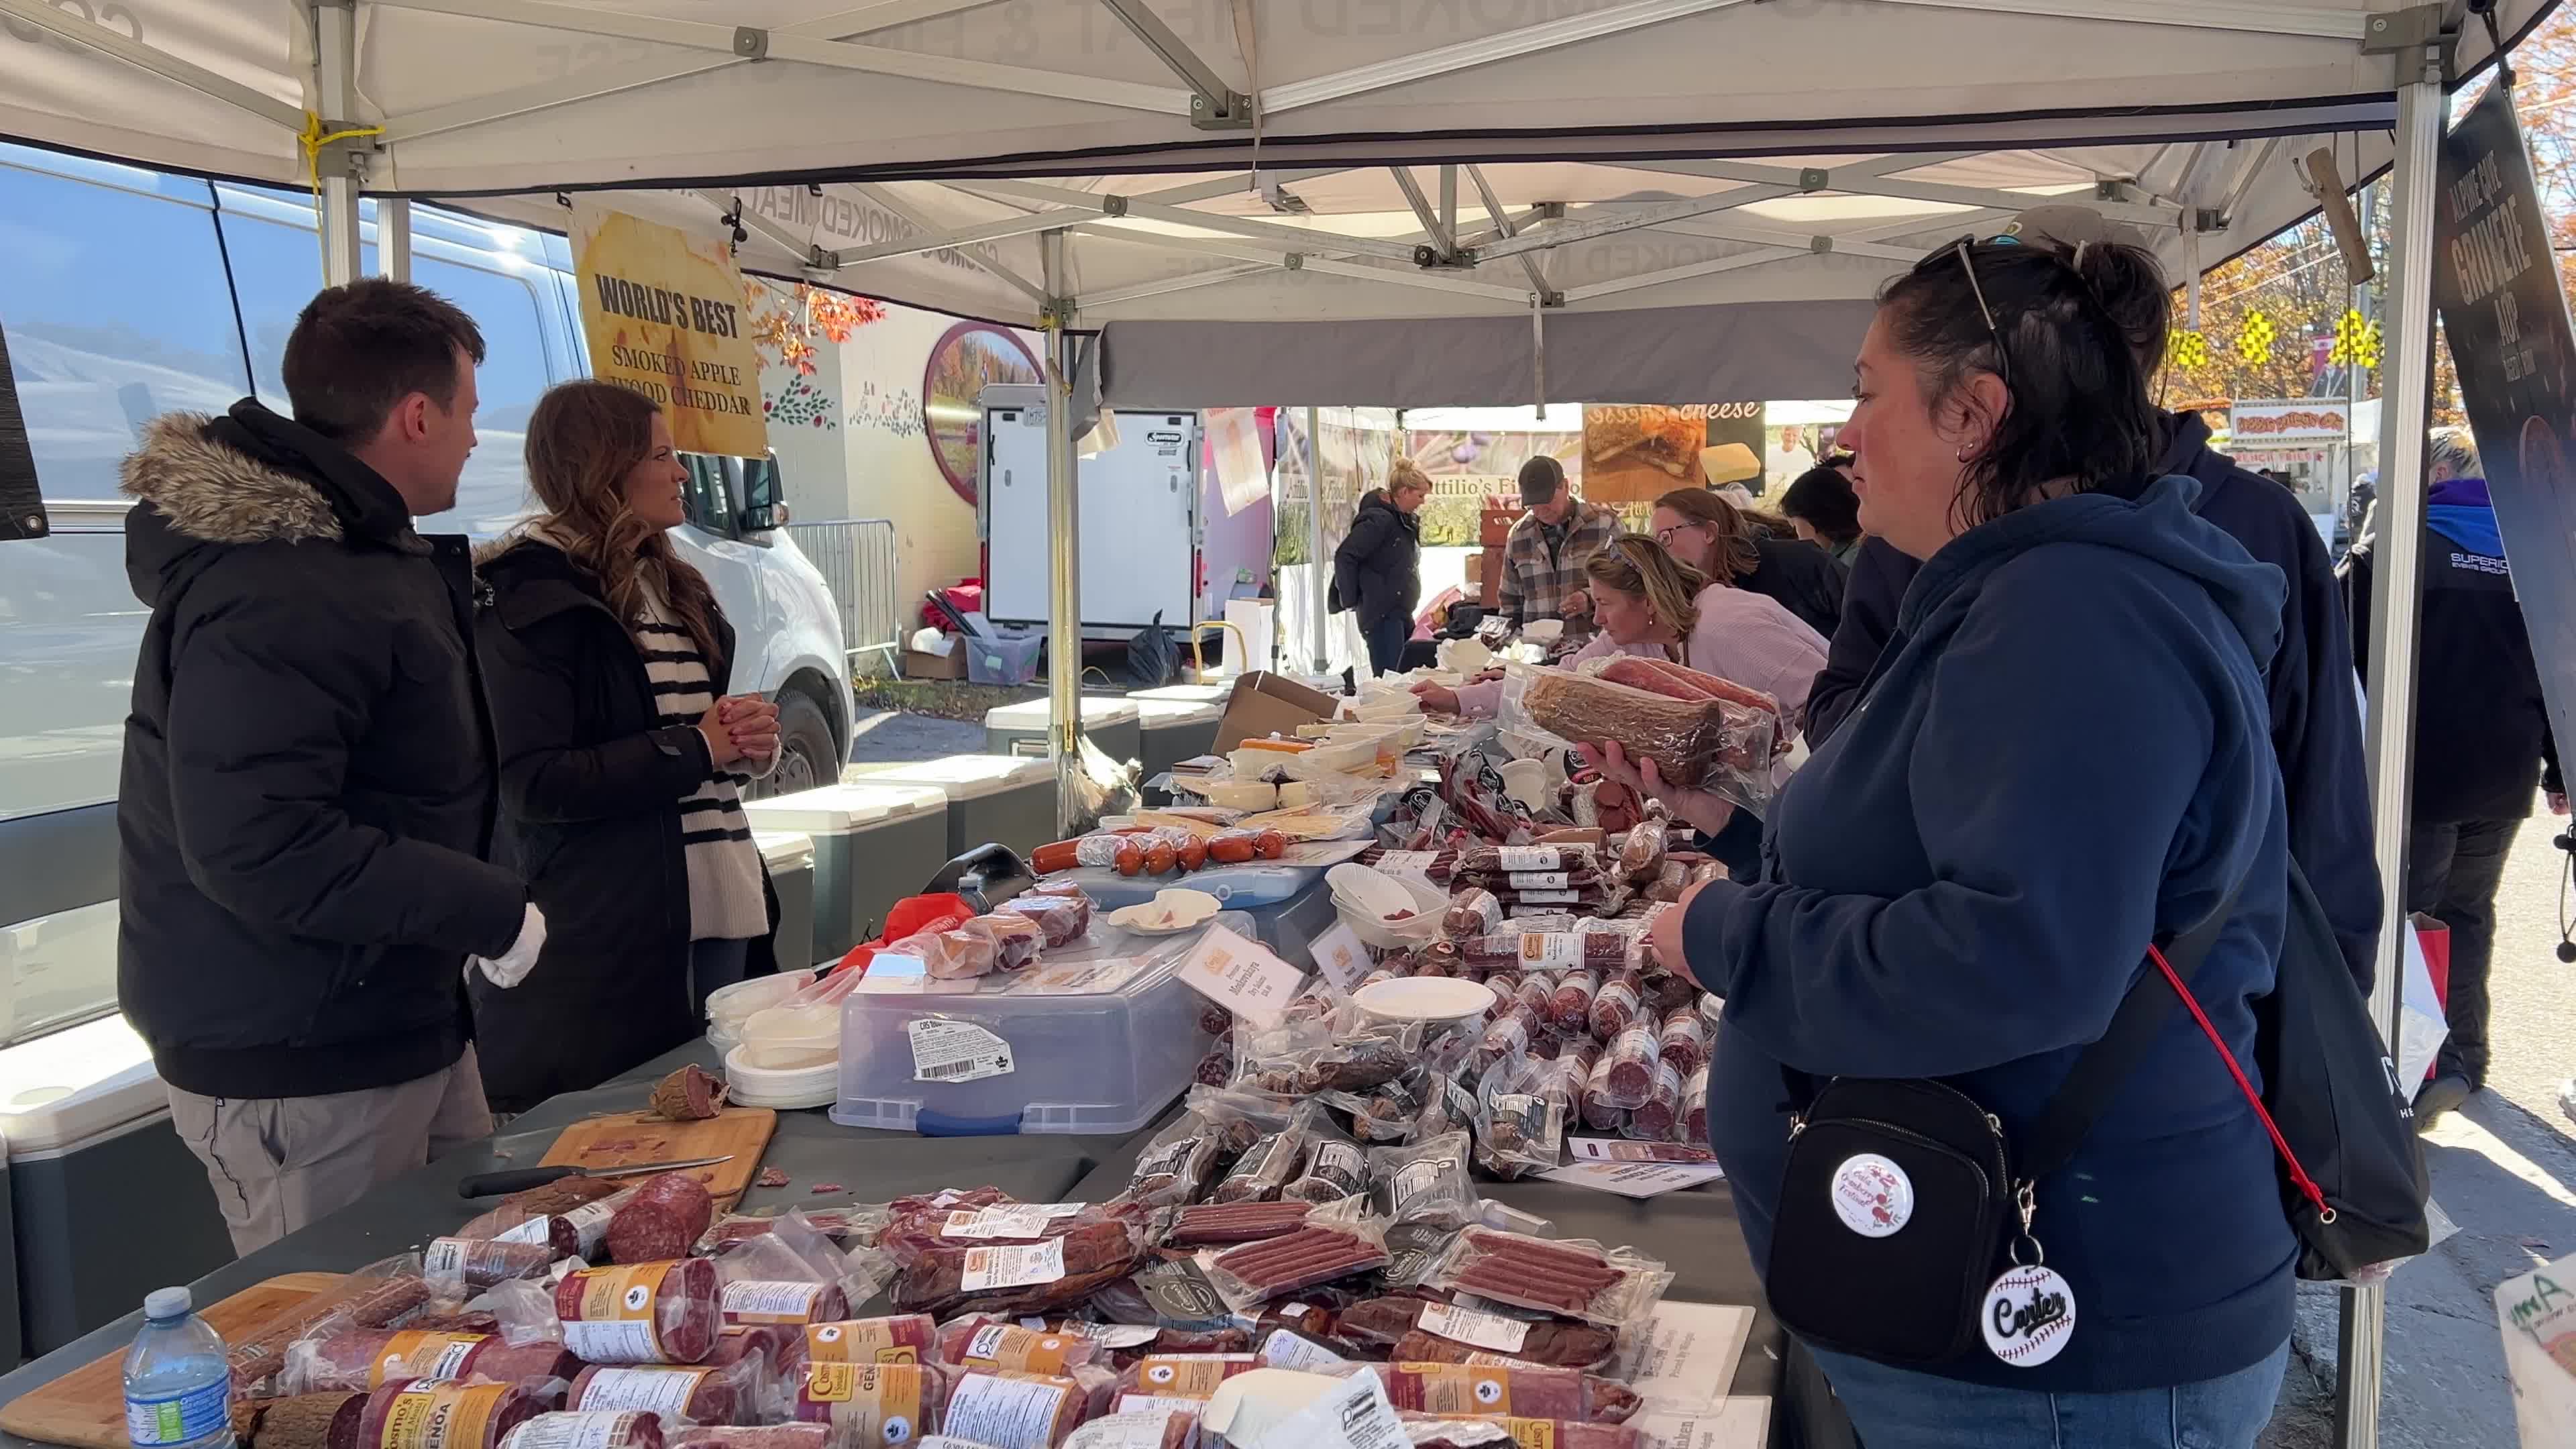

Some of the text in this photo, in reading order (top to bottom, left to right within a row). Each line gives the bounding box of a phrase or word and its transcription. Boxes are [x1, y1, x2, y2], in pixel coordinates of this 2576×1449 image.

[595, 273, 739, 339] WORLD'S BEST
[612, 345, 741, 386] SMOKED APPLE
[671, 386, 751, 416] CHEDDAR
[2232, 451, 2275, 462] RENCH
[1434, 477, 1493, 494] ttilio's
[2451, 553, 2510, 570] SUPERIO
[1994, 1287, 2066, 1339] Carter
[812, 1363, 833, 1395] Cosm
[863, 1363, 875, 1391] GEN
[385, 1398, 413, 1449] osmo's
[430, 1403, 451, 1449] ENOA
